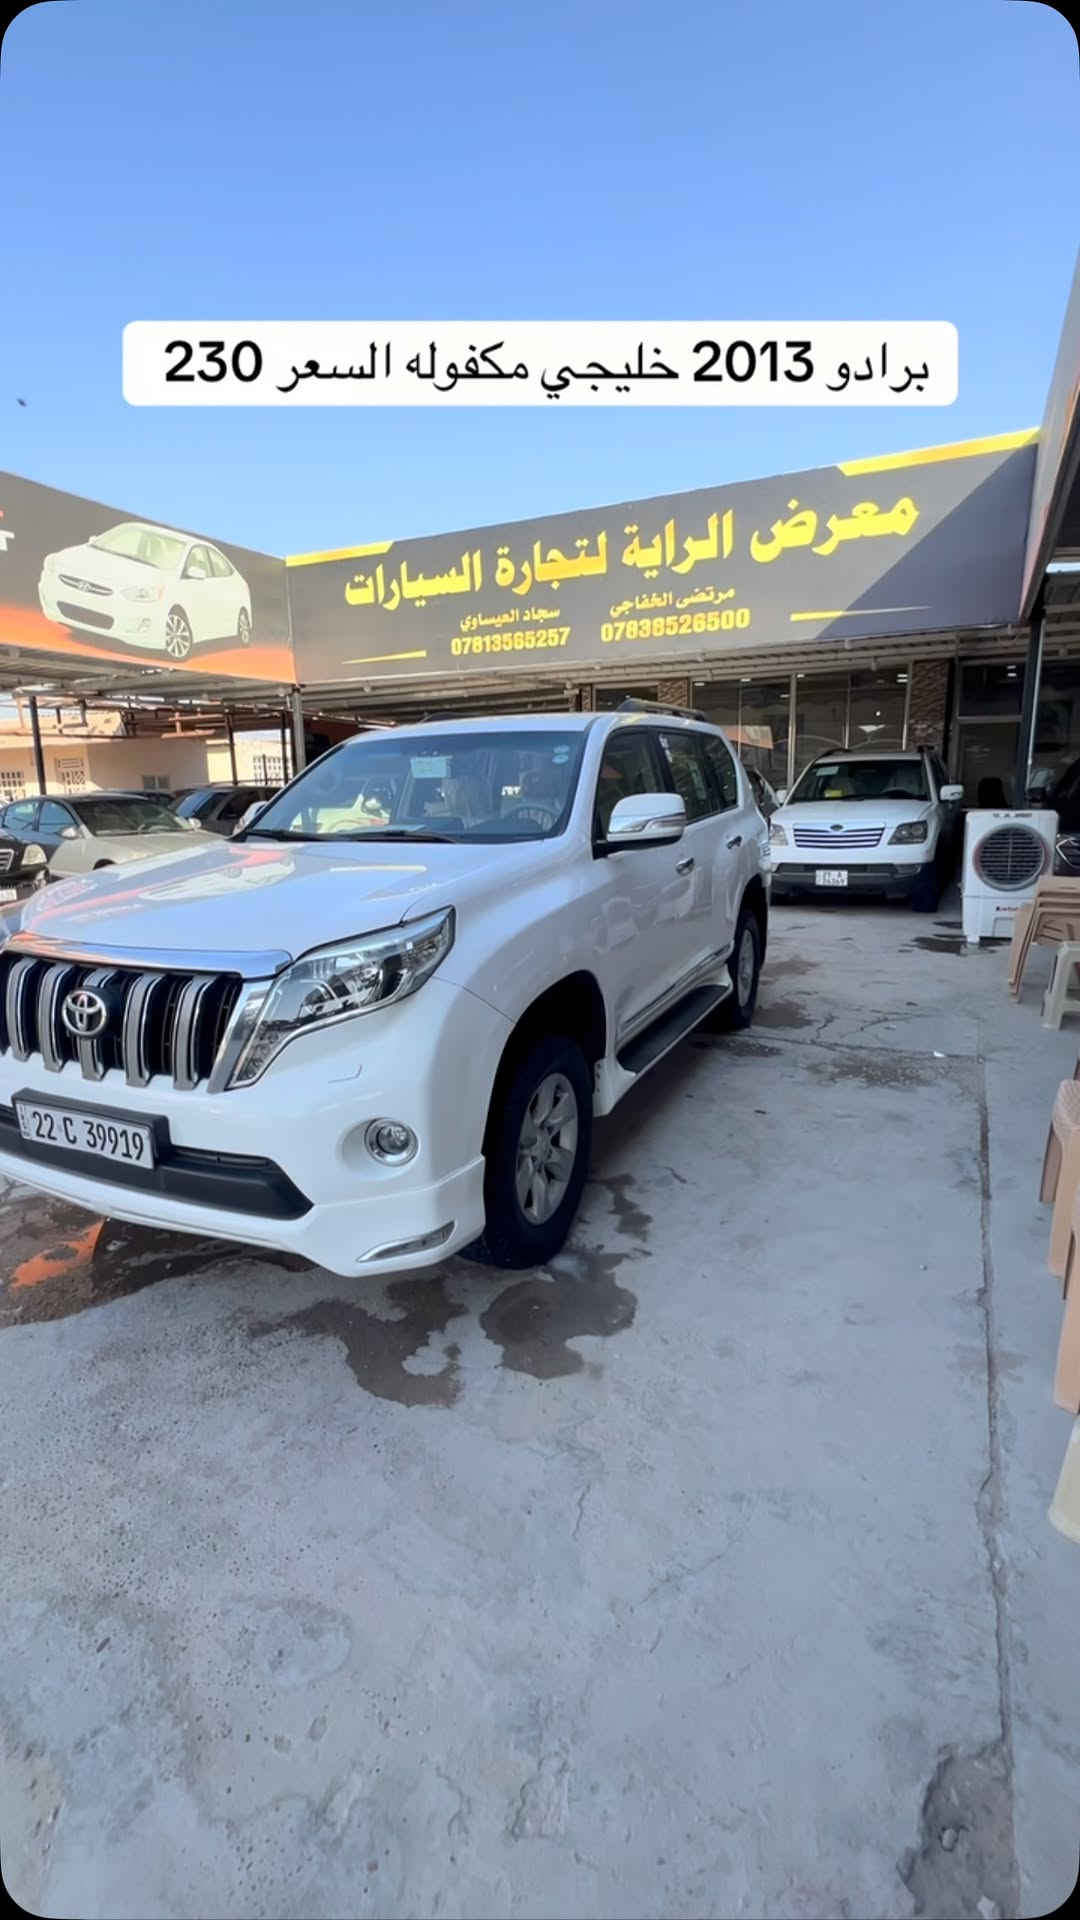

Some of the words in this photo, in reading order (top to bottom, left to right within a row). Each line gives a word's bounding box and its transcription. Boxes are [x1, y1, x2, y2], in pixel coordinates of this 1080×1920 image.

[621, 509, 734, 579] الراية
[749, 496, 920, 563] معرض
[344, 549, 482, 611] السيارات
[495, 530, 608, 596] لتجارة
[522, 607, 561, 623] سجاد
[32, 1111, 57, 1141] 22
[62, 1116, 77, 1145] C
[82, 1120, 144, 1161] 39919
